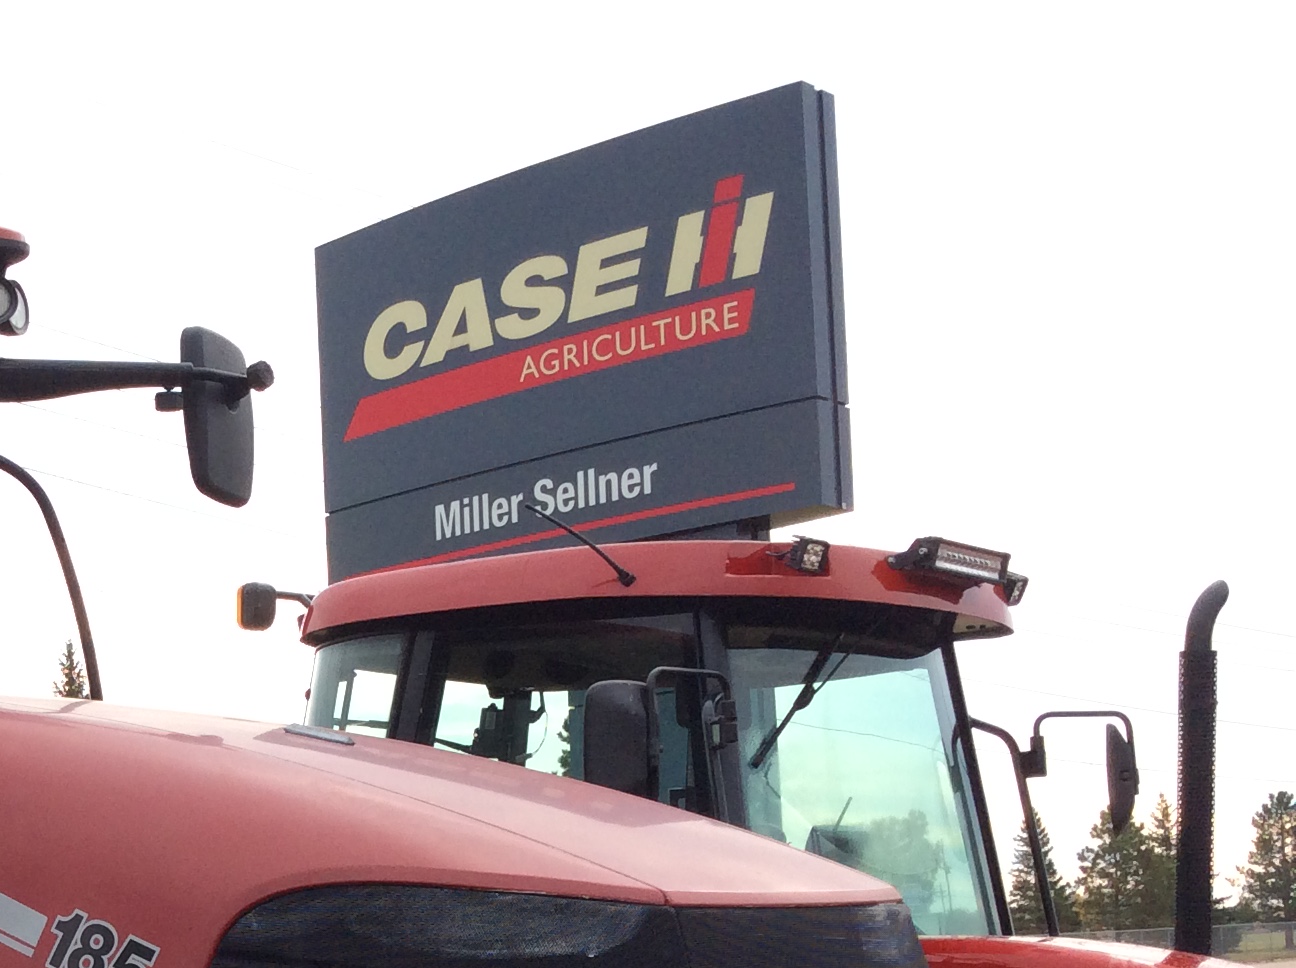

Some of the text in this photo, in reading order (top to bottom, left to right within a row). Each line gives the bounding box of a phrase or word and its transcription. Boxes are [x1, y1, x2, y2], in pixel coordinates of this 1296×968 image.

[363, 173, 774, 381] CASE IH
[519, 300, 740, 382] AGRICULTURE
[434, 461, 658, 541] Miller Sellner
